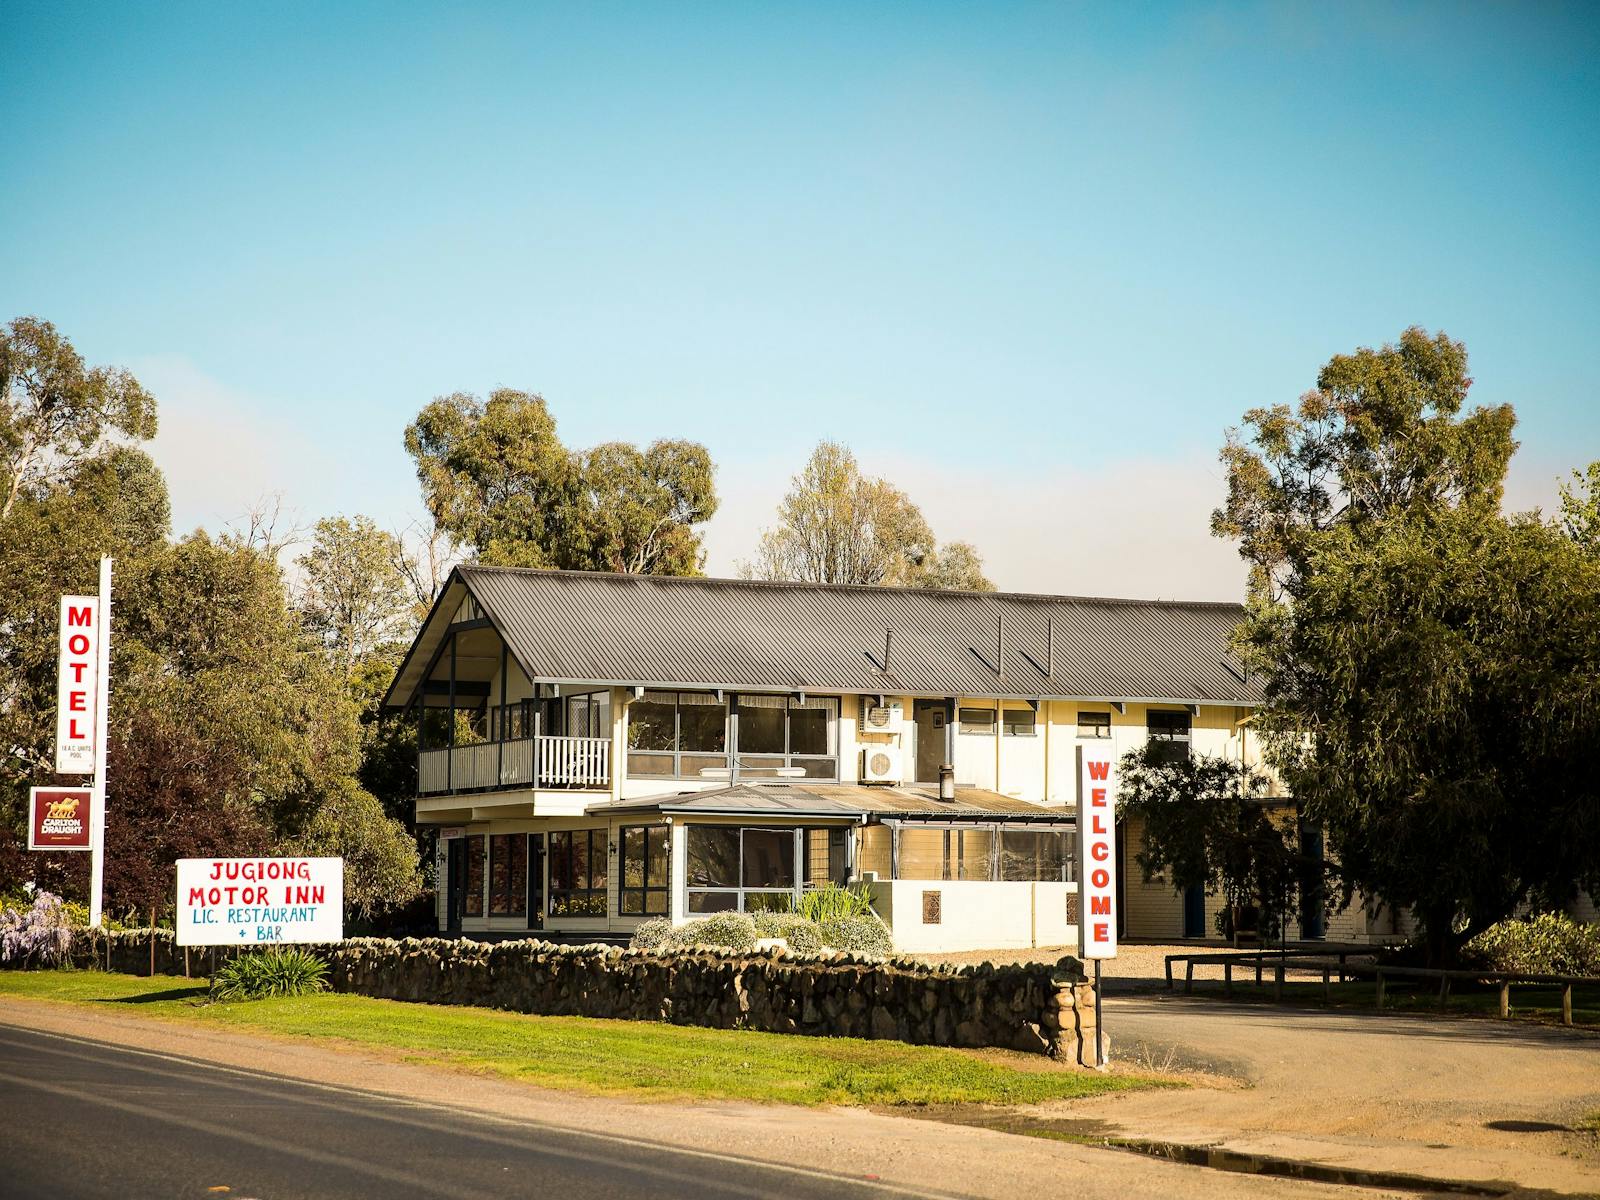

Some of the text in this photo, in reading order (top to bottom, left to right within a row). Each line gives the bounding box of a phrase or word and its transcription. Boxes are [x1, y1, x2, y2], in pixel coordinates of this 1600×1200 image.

[68, 606, 92, 740] MOTEL
[41, 825, 83, 834] DRAUGHT
[43, 818, 81, 827] CARLTON
[1087, 761, 1111, 942] WELCOME
[210, 861, 311, 883] JUGIONG
[188, 885, 325, 907] MOTOR INN
[192, 906, 317, 924] LIC. RESTAURANT
[256, 925, 283, 941] BAR
